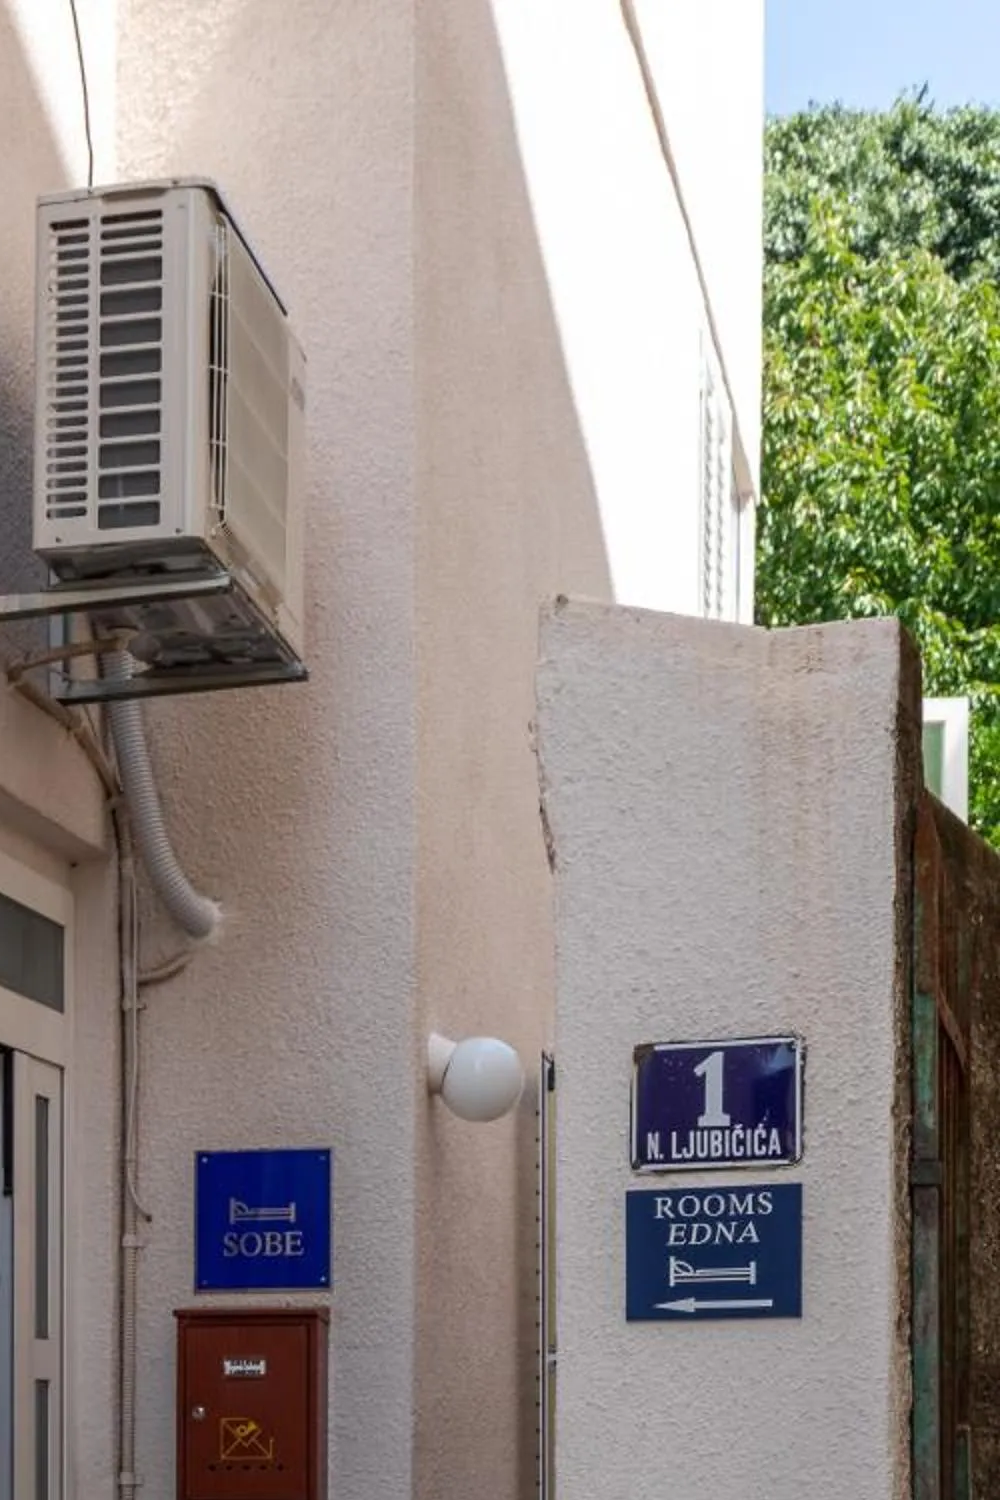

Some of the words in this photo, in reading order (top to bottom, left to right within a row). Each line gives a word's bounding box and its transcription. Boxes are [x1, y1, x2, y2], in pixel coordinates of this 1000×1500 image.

[693, 1051, 731, 1127] 1
[647, 1131, 664, 1160] N.
[671, 1123, 782, 1159] LJUBIČIĆA
[653, 1191, 773, 1219] ROOMS
[223, 1231, 304, 1257] SOBE
[666, 1221, 760, 1246] EDNA
